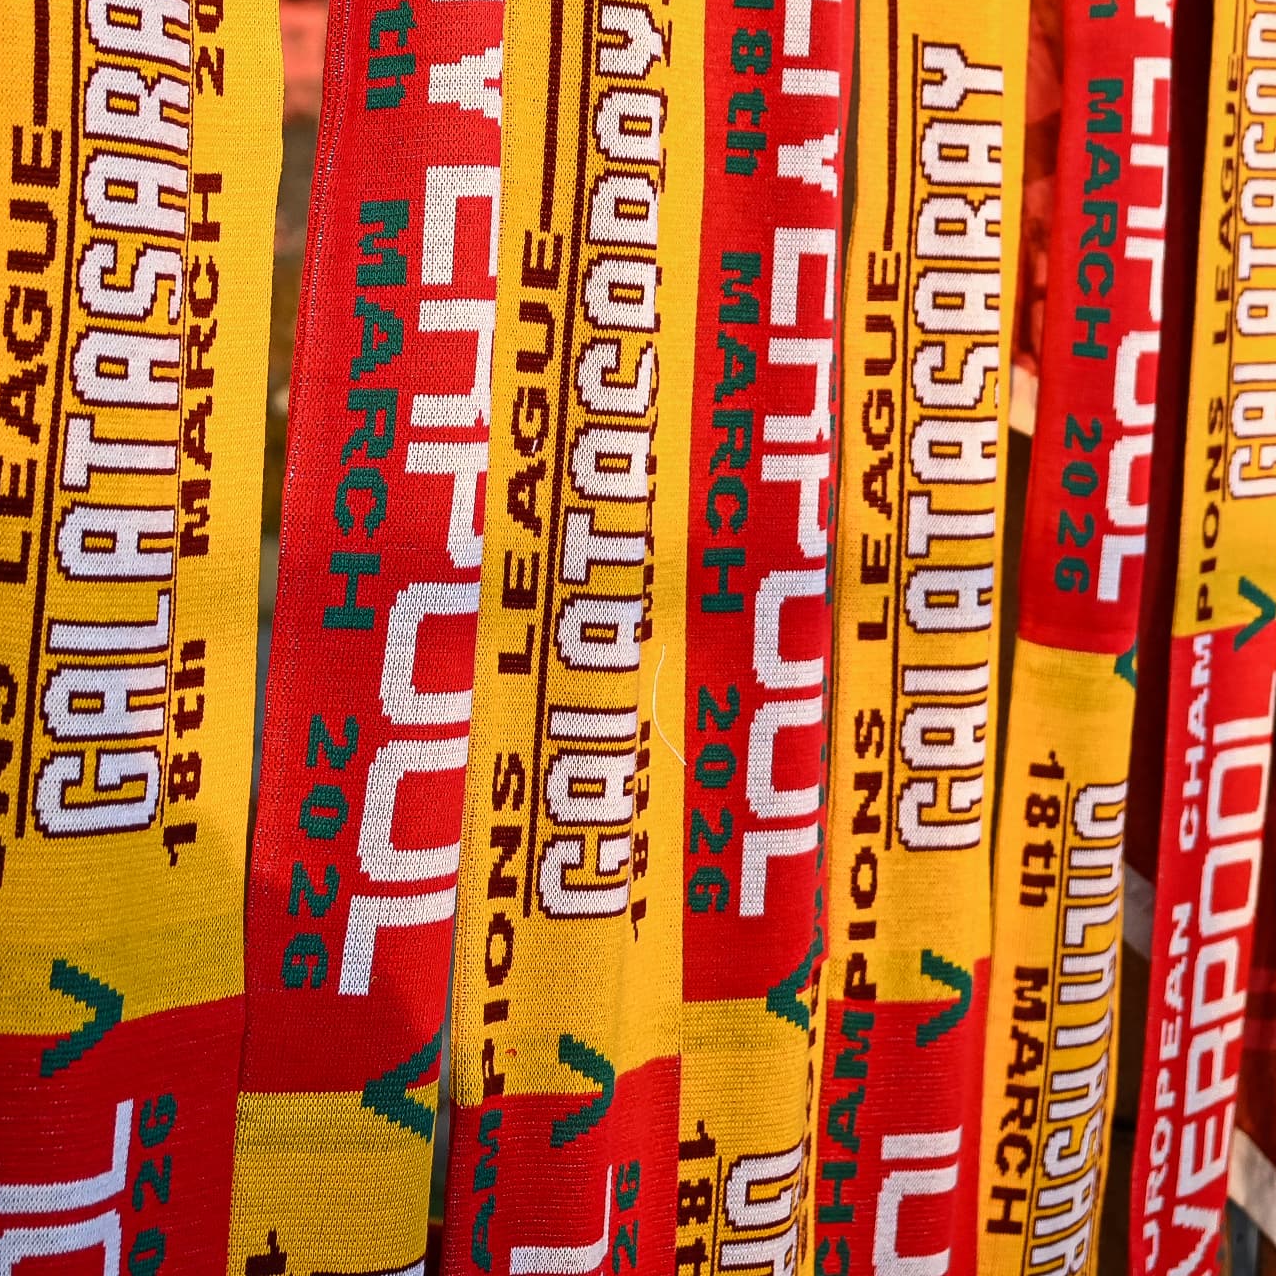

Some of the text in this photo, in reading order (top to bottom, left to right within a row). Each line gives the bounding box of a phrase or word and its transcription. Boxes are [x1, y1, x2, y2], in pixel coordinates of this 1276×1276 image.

[178, 172, 223, 557] MARCH
[1071, 77, 1125, 361] MARCH
[322, 199, 409, 630] MARCH
[497, 226, 563, 675] LEAGUE
[700, 251, 762, 614] MARCH
[896, 40, 1004, 853] GALATASARAY
[1054, 411, 1103, 595] 2026
[1178, 394, 1226, 852] CHAMPIONS
[1212, 52, 1240, 345] LEAGUE
[162, 640, 208, 866] 18th
[280, 714, 359, 989] 2026
[686, 683, 742, 914] 2026
[813, 708, 886, 1276] CHAMPIONS
[856, 250, 901, 641] LEAGUE
[985, 750, 1066, 1237] 18th MARCH
